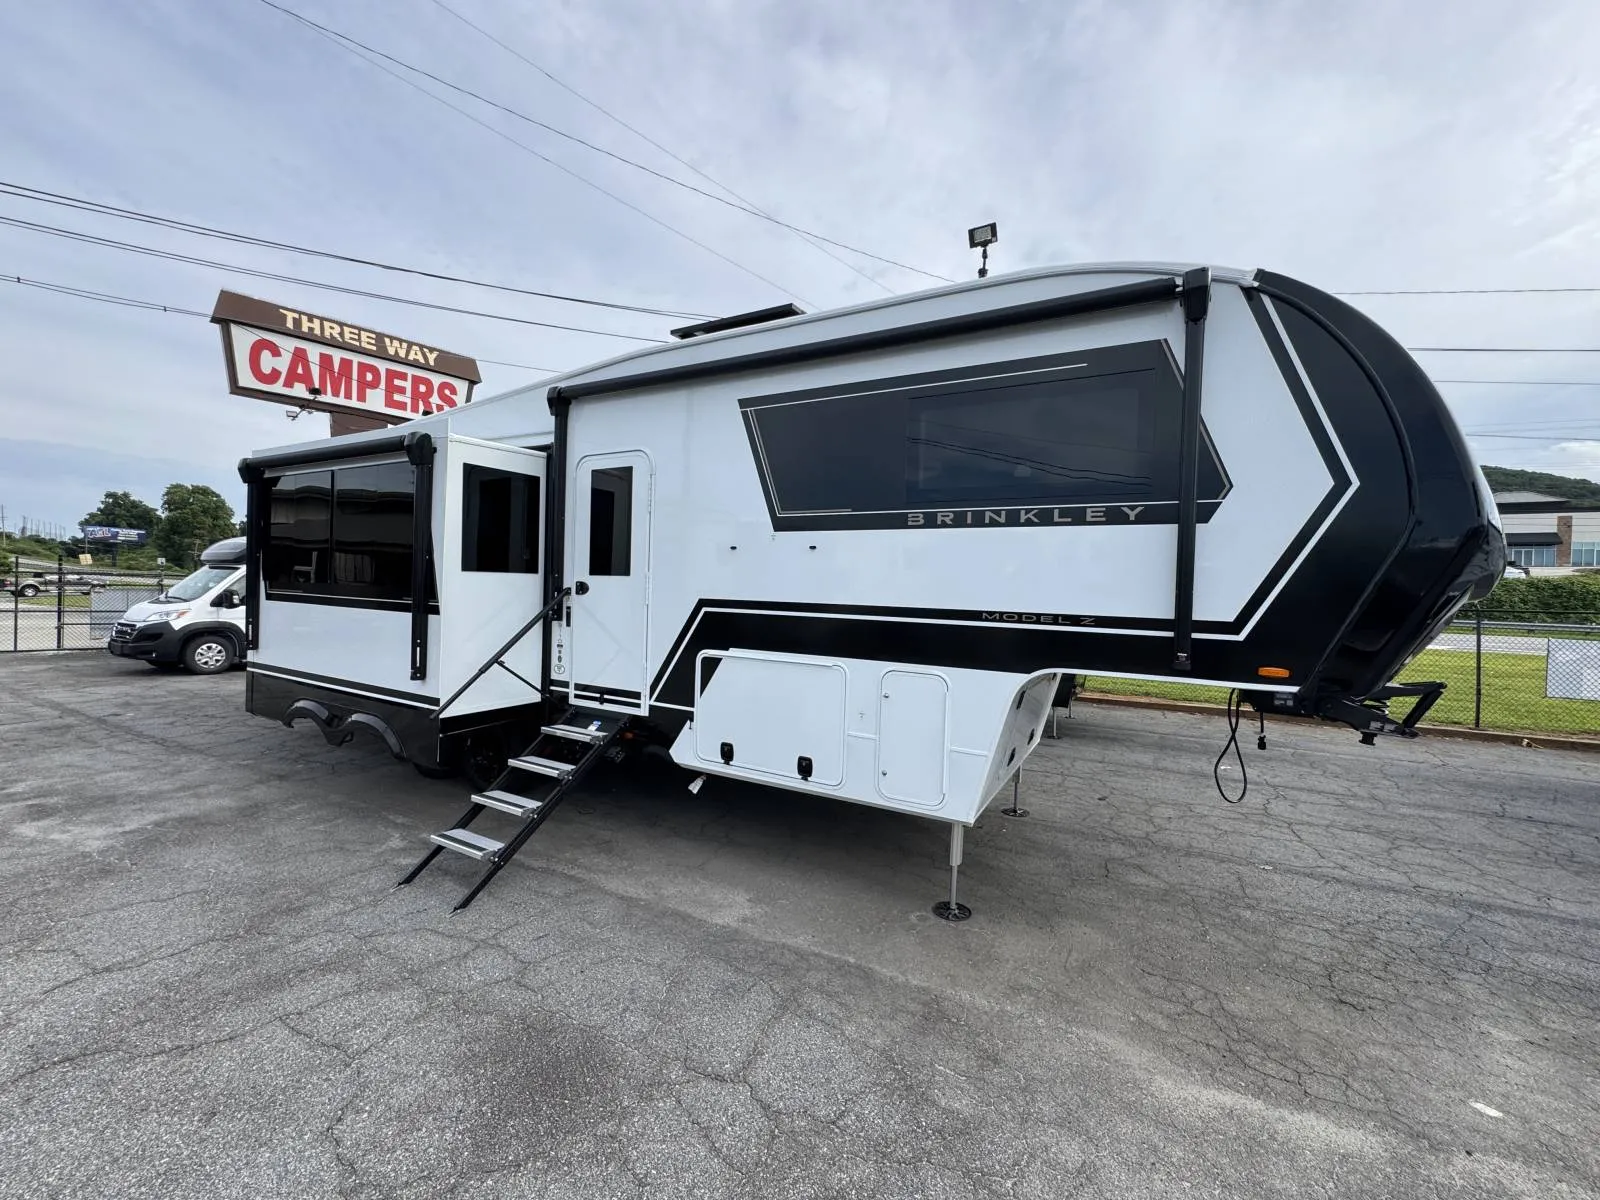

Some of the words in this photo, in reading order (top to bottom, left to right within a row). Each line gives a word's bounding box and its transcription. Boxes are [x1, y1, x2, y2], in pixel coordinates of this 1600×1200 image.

[279, 309, 377, 350] THREE
[385, 338, 440, 366] WAY
[249, 339, 458, 415] CAMPERS
[907, 506, 1145, 526] BRINKLEY
[982, 612, 1071, 624] MODEL
[1079, 617, 1096, 625] Z
